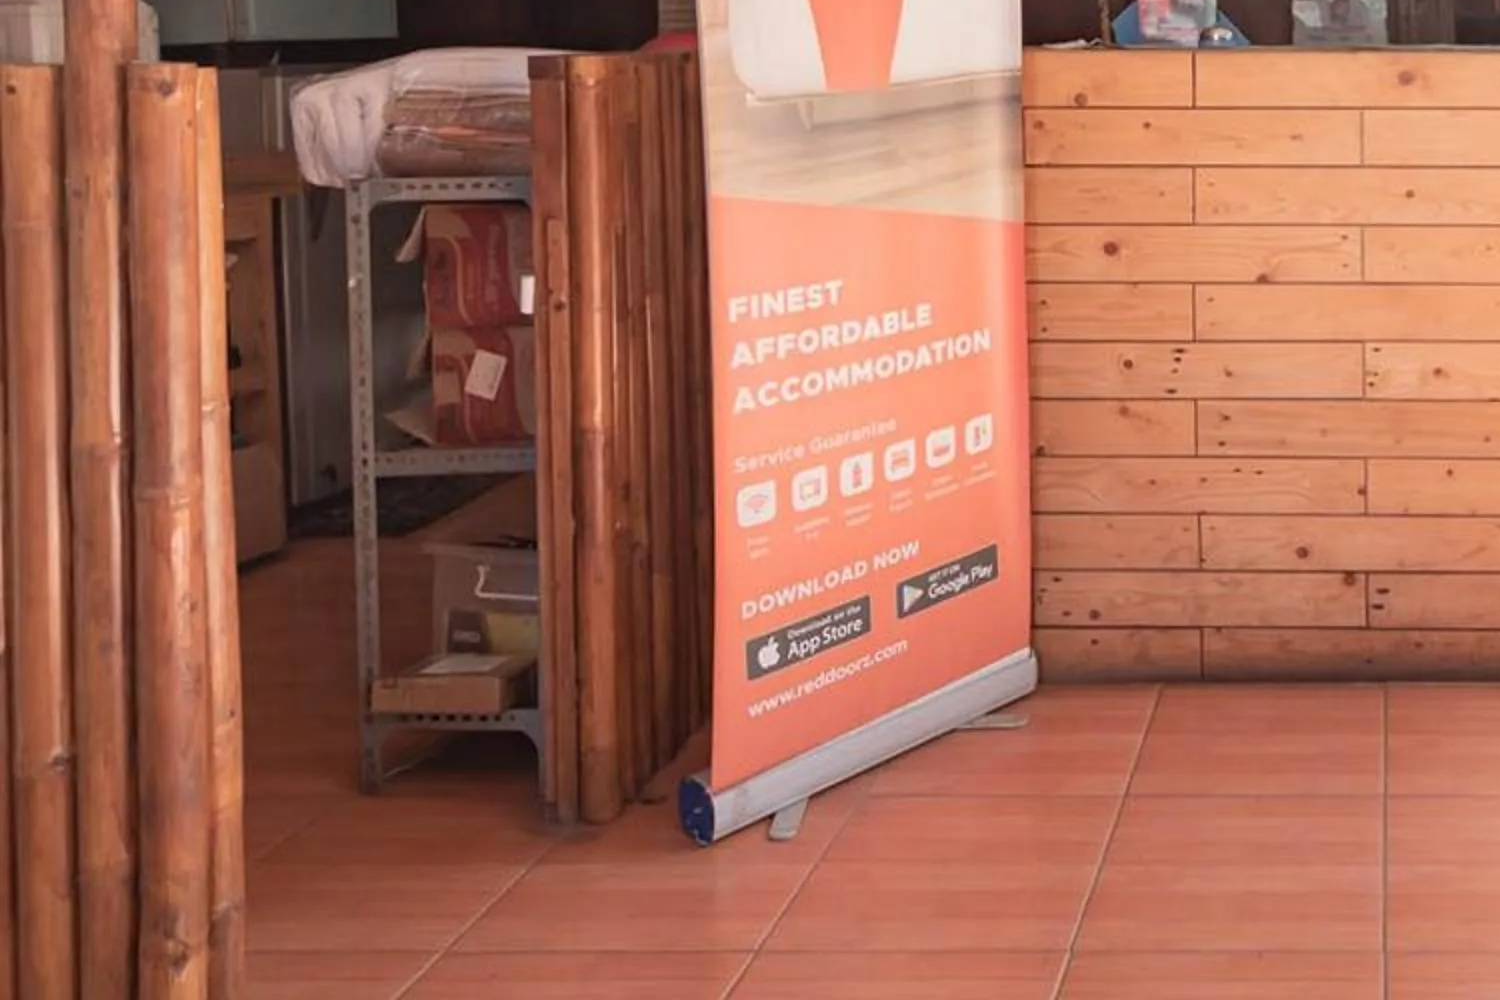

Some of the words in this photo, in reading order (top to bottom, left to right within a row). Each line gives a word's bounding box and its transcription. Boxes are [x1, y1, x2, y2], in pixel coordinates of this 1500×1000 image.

[728, 279, 843, 323] FINEST
[731, 303, 932, 370] AFFORDABLE
[733, 327, 992, 415] ACCOMMODATION
[735, 443, 805, 473] Service
[741, 559, 869, 621] DOWNLOAD
[872, 539, 920, 571] NOW
[928, 572, 970, 600] Google
[971, 562, 993, 585] Play
[786, 636, 821, 661] App
[822, 617, 864, 646] Store
[747, 638, 909, 718] www.reddoorz.com
